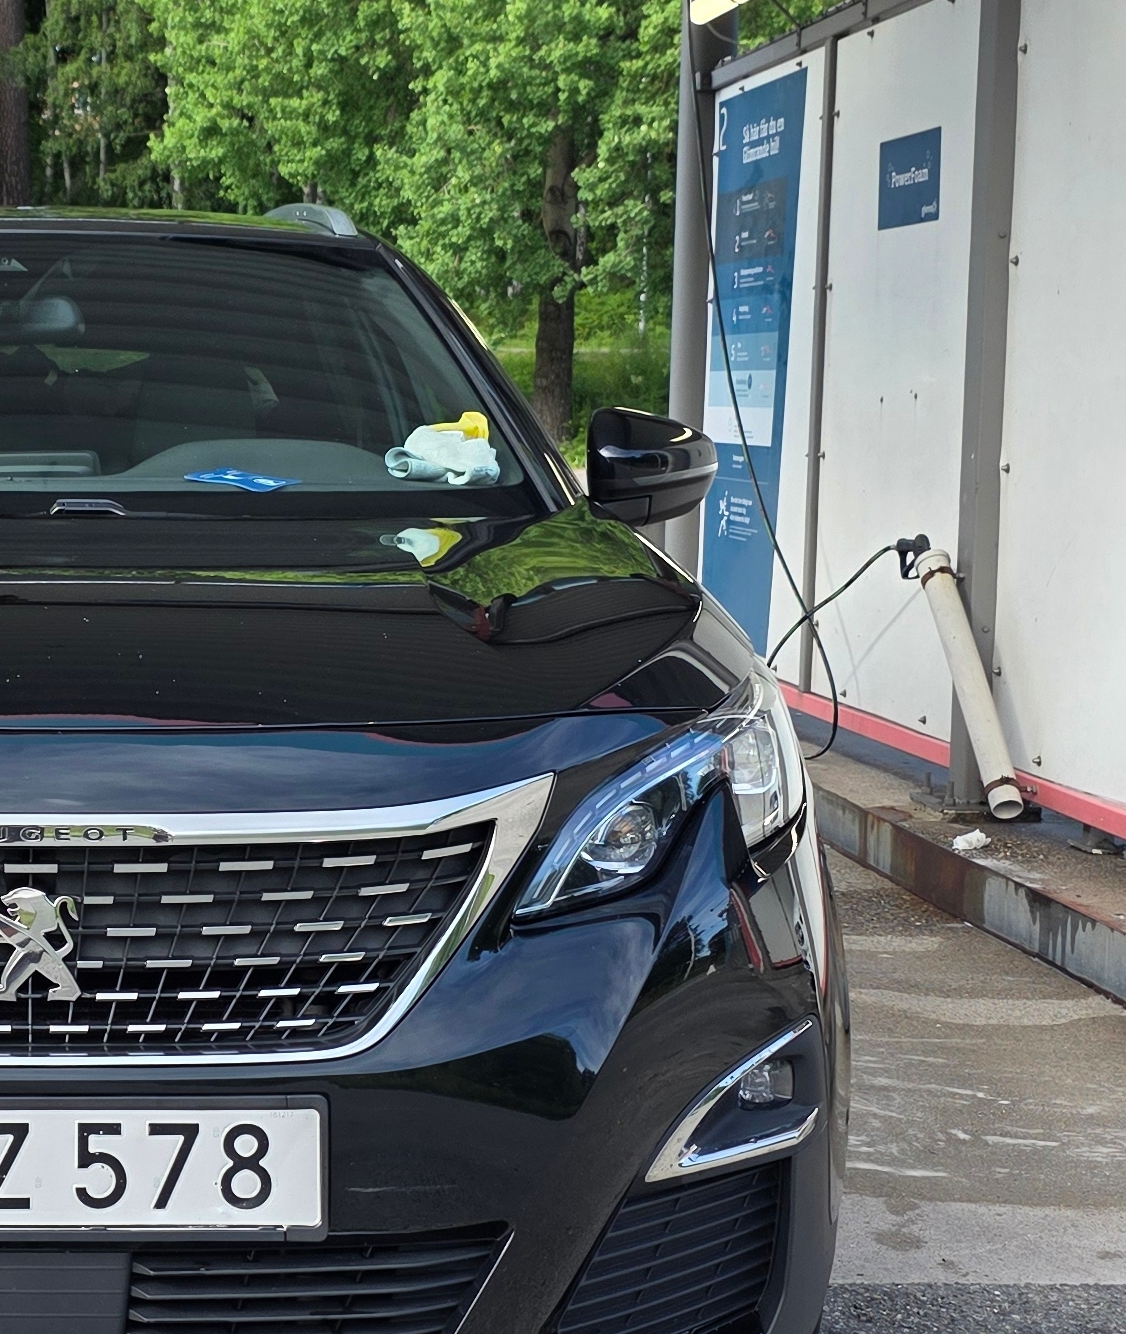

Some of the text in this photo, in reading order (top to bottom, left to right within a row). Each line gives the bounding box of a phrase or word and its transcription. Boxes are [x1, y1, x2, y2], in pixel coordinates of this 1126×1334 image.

[742, 123, 750, 144] Så
[769, 116, 777, 135] du
[777, 117, 785, 132] en
[891, 167, 929, 188] PowerFoam
[73, 1121, 273, 1211] 578
